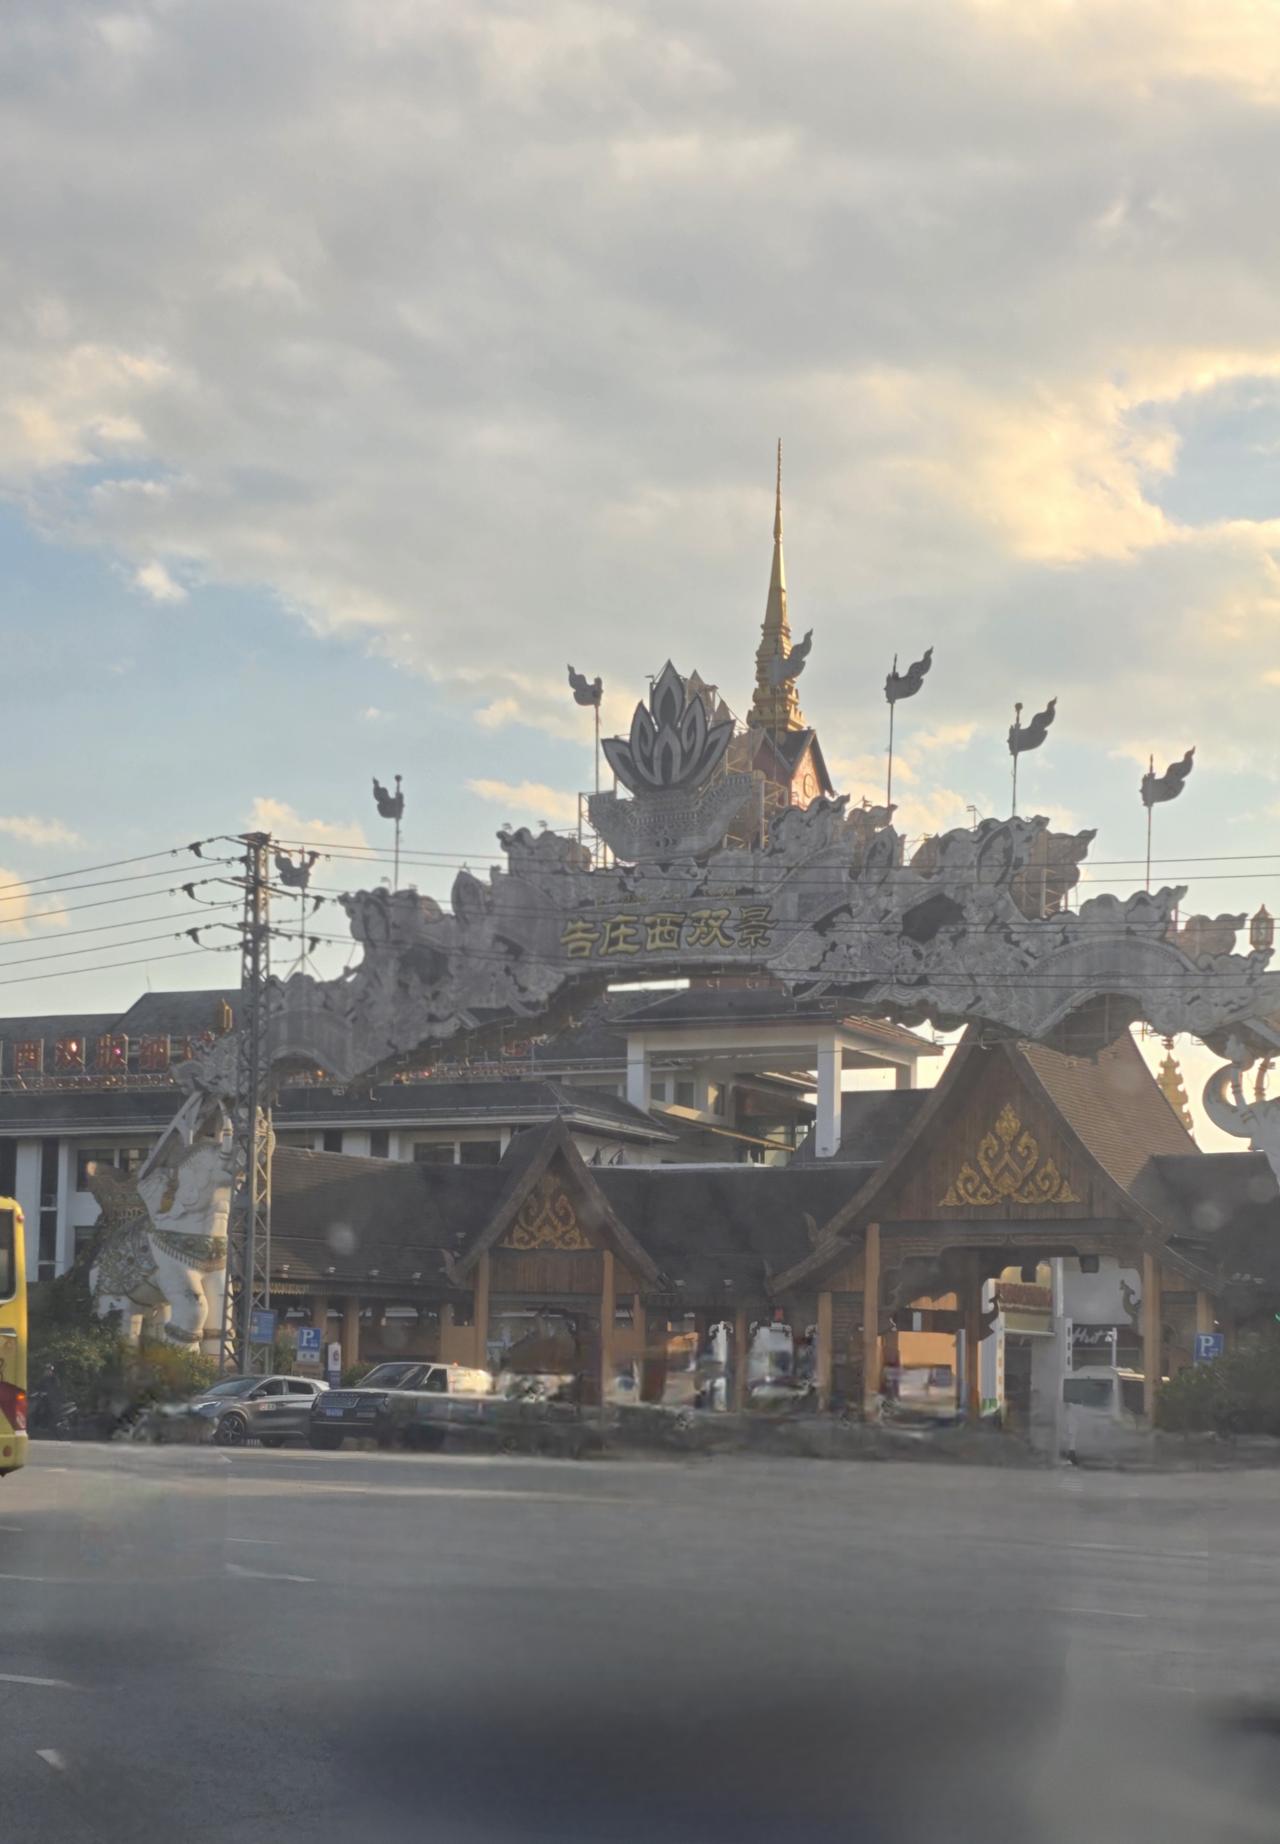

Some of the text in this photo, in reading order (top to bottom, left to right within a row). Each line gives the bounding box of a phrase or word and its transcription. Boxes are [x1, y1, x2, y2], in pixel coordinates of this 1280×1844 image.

[560, 906, 778, 958] 告庄西双景
[301, 1329, 314, 1346] P
[1200, 1335, 1214, 1356] P
